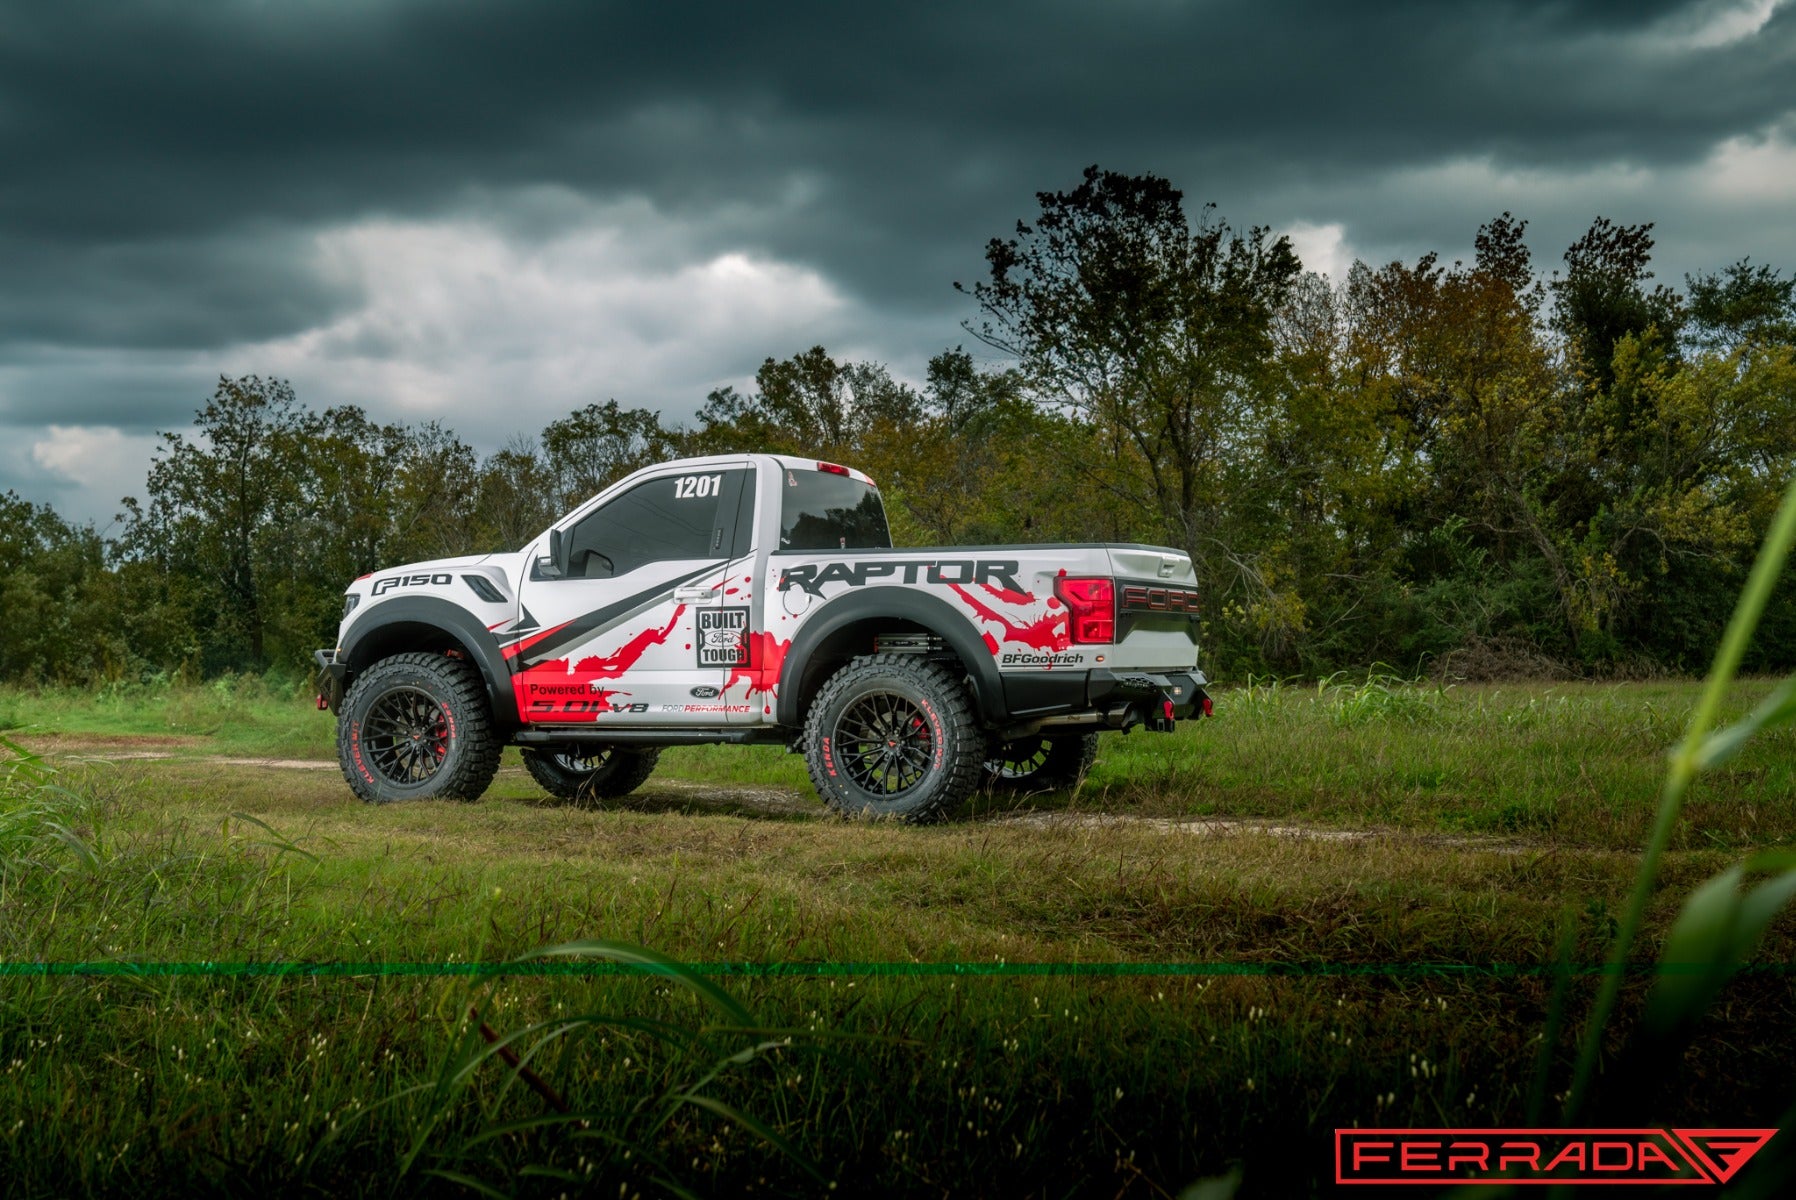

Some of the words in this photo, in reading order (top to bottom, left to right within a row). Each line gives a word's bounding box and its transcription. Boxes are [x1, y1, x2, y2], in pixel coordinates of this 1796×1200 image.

[674, 474, 722, 499] 1201
[371, 573, 453, 597] F150
[779, 560, 1028, 601] RAPTOR
[1121, 585, 1200, 613] FORD
[701, 612, 745, 630] BUILT
[711, 632, 735, 644] Ford
[703, 648, 745, 662] TOUGH
[1002, 653, 1084, 664] BFGoodrich
[530, 684, 585, 696] Powered
[589, 683, 605, 699] by
[695, 688, 714, 697] Ford
[921, 699, 943, 746] KLEVER
[822, 737, 837, 777] KENDA
